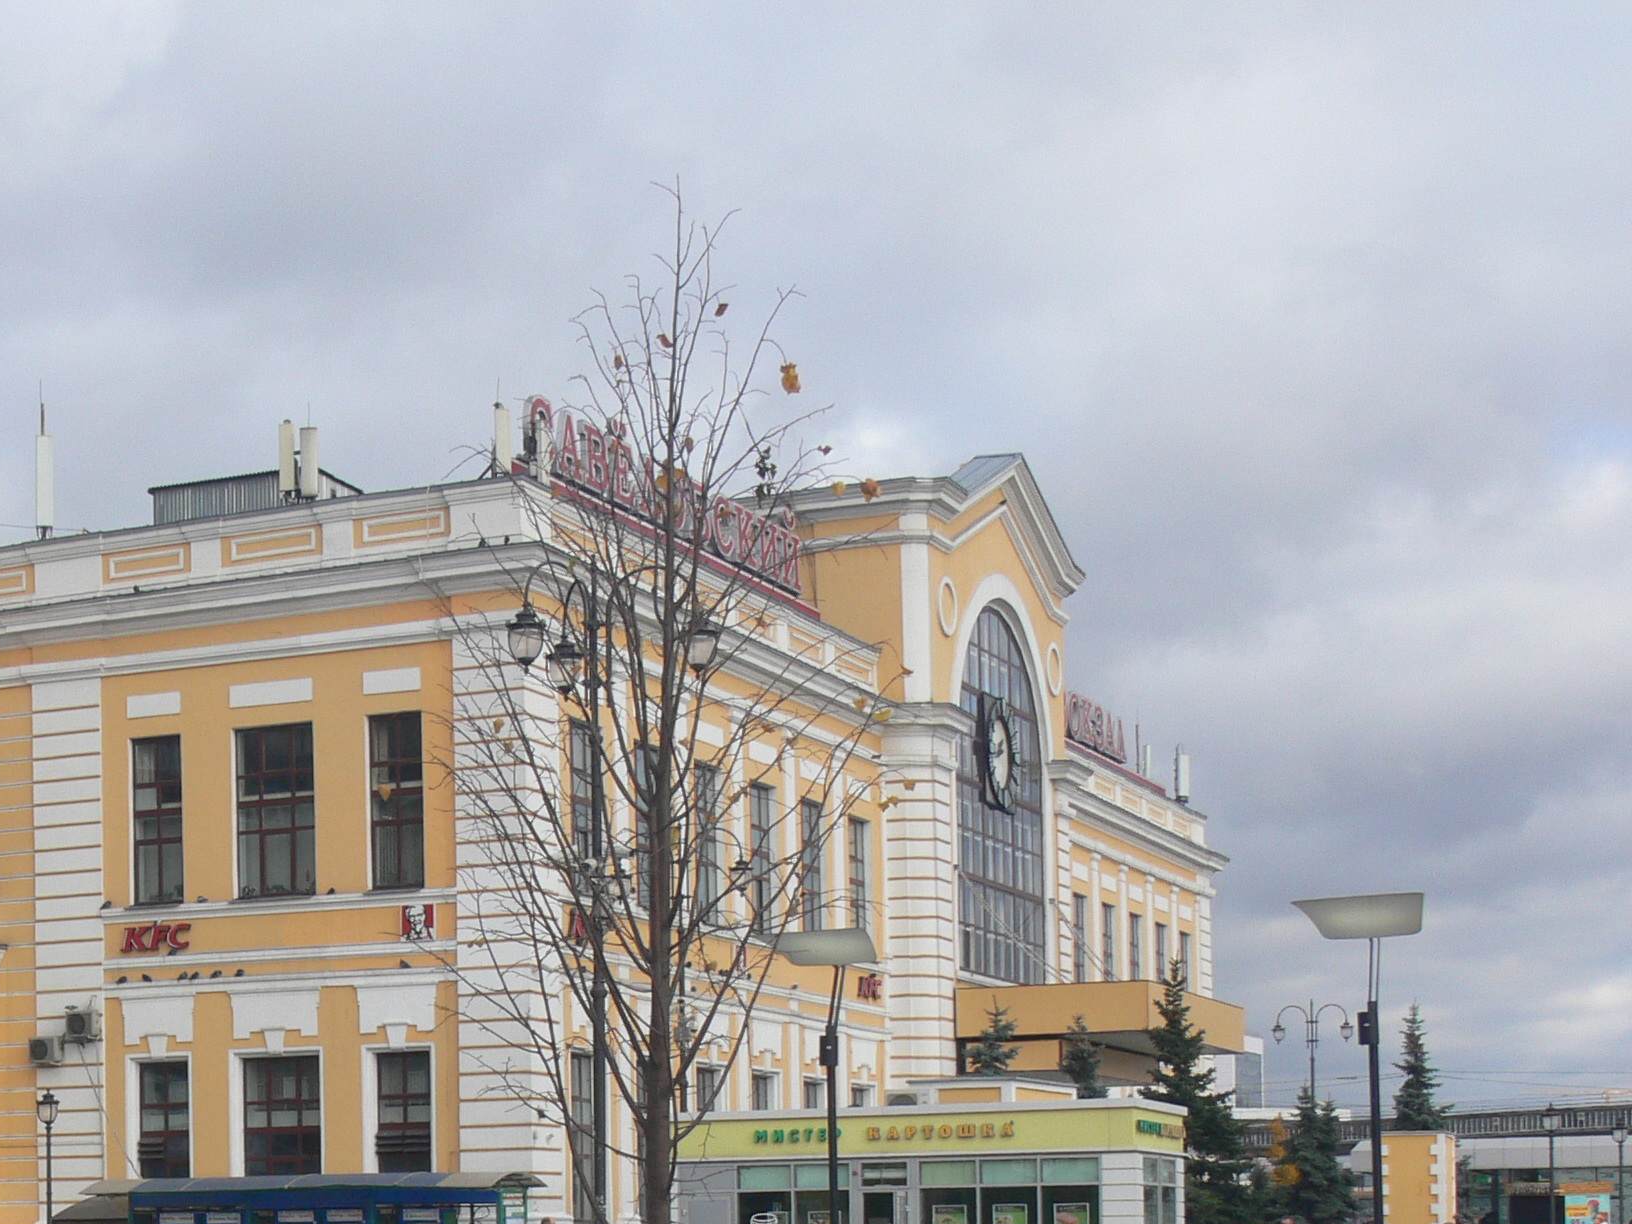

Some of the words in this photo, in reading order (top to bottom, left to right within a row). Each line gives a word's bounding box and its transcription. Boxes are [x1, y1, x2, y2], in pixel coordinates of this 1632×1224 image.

[1064, 690, 1127, 762] ОКЗАЛ
[120, 923, 191, 952] KFC
[868, 1122, 1013, 1141] КАРТОШКА
